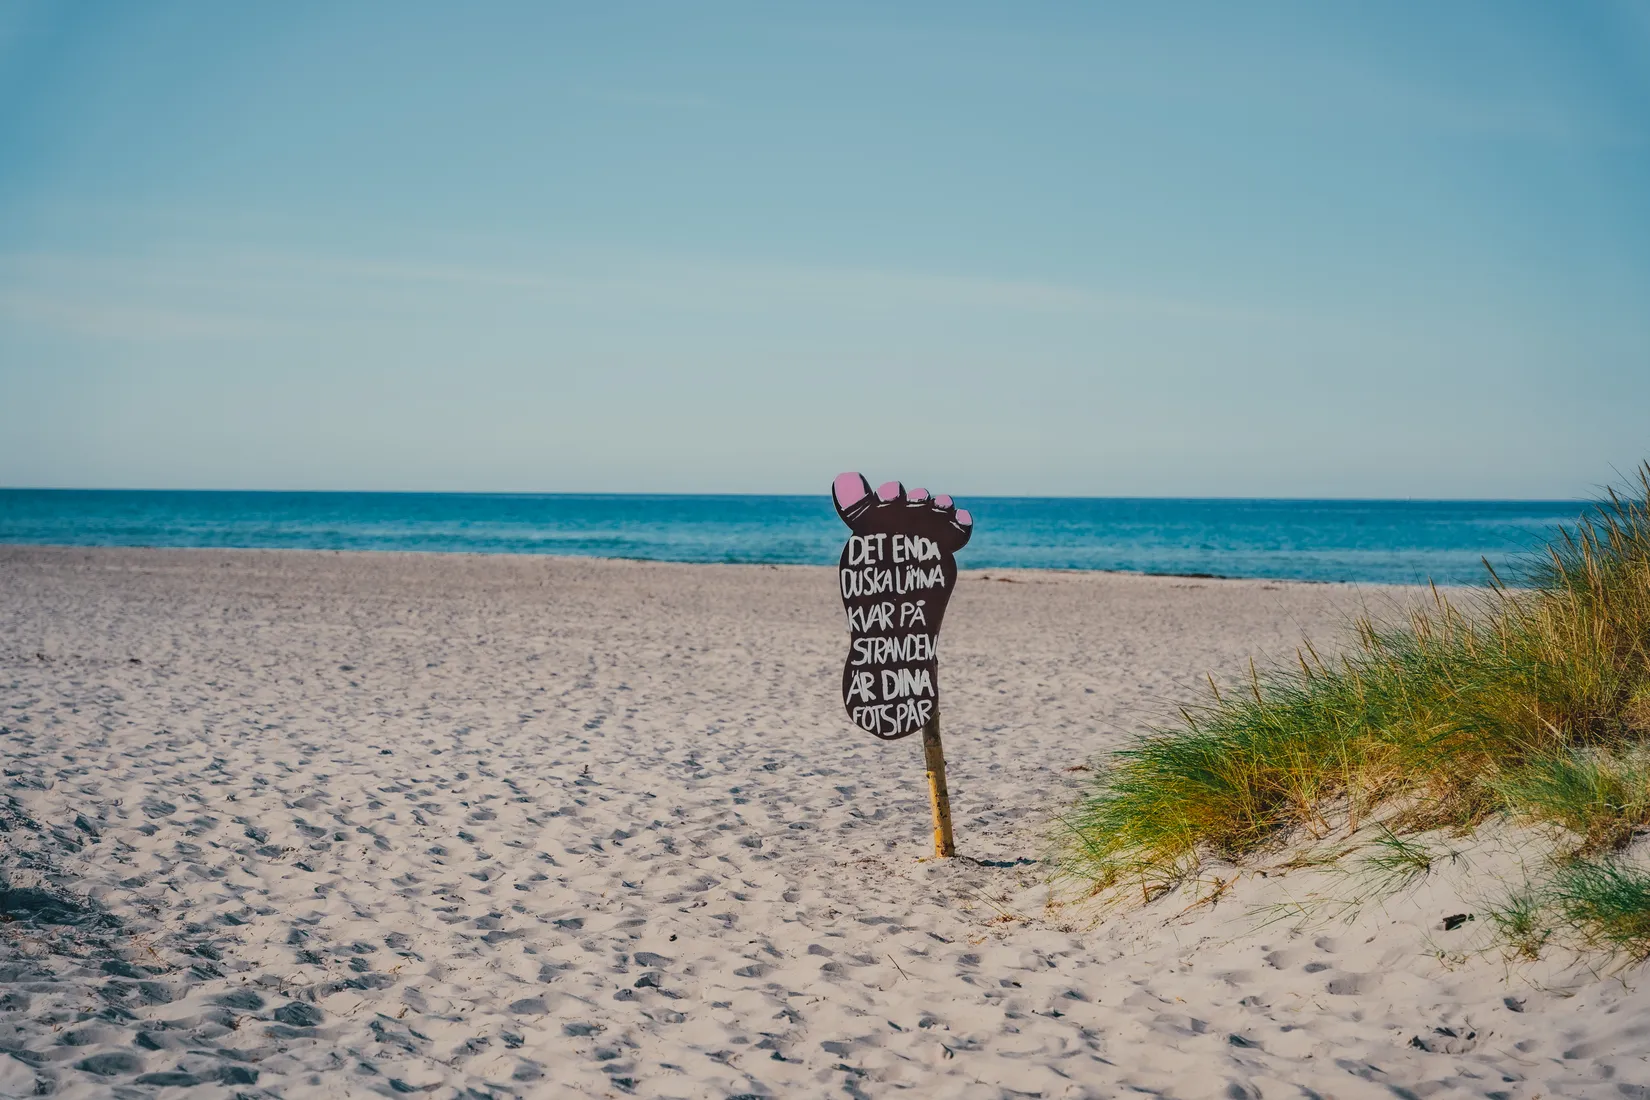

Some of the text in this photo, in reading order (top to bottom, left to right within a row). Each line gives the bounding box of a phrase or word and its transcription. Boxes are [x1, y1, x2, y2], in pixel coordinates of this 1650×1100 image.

[849, 533, 941, 565] DET ENDA
[896, 564, 945, 594] LÄMNA
[848, 600, 926, 633] KVAR PÅ
[851, 634, 937, 665] STRANDEN
[846, 668, 935, 705] ÄR DINA
[853, 698, 932, 736] FOTSPÅR
